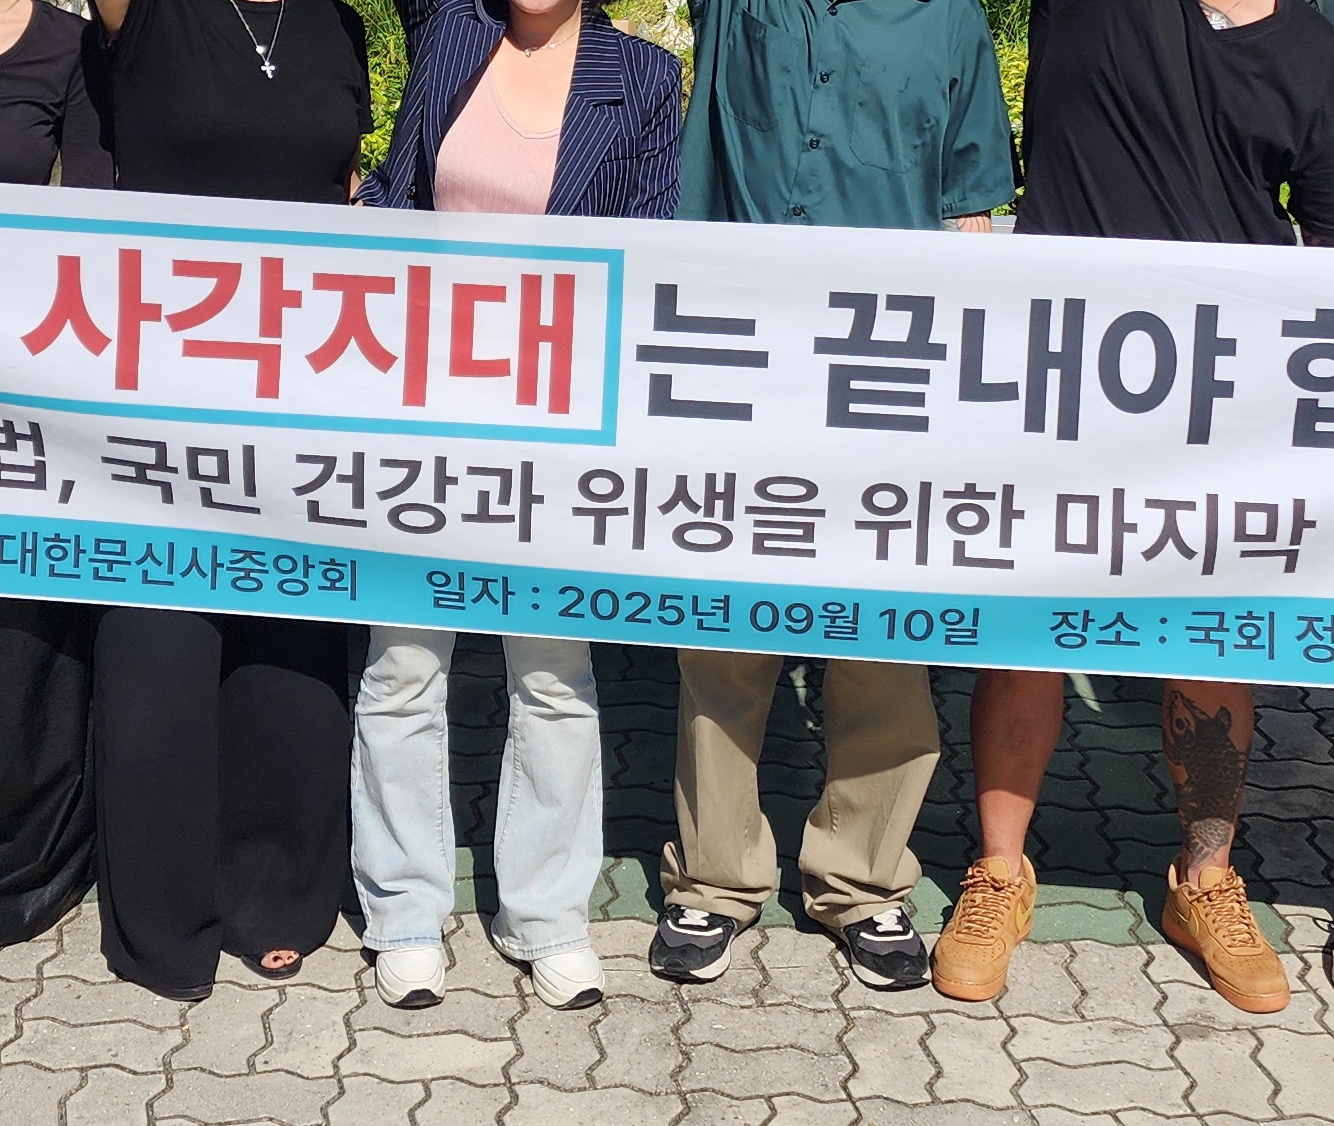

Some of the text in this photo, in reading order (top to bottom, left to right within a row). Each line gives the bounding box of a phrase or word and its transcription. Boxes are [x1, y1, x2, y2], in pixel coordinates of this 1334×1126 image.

[814, 291, 1237, 446] 끝내야
[100, 434, 262, 514] 국민
[293, 451, 544, 544] 건강과
[571, 467, 827, 559] 위생을
[853, 480, 1025, 571] 위한
[1054, 488, 1317, 576] 마지막
[558, 585, 731, 634] 2025년
[749, 600, 861, 642] 09월
[878, 606, 980, 648] 10일
[1185, 609, 1276, 661] 국회
